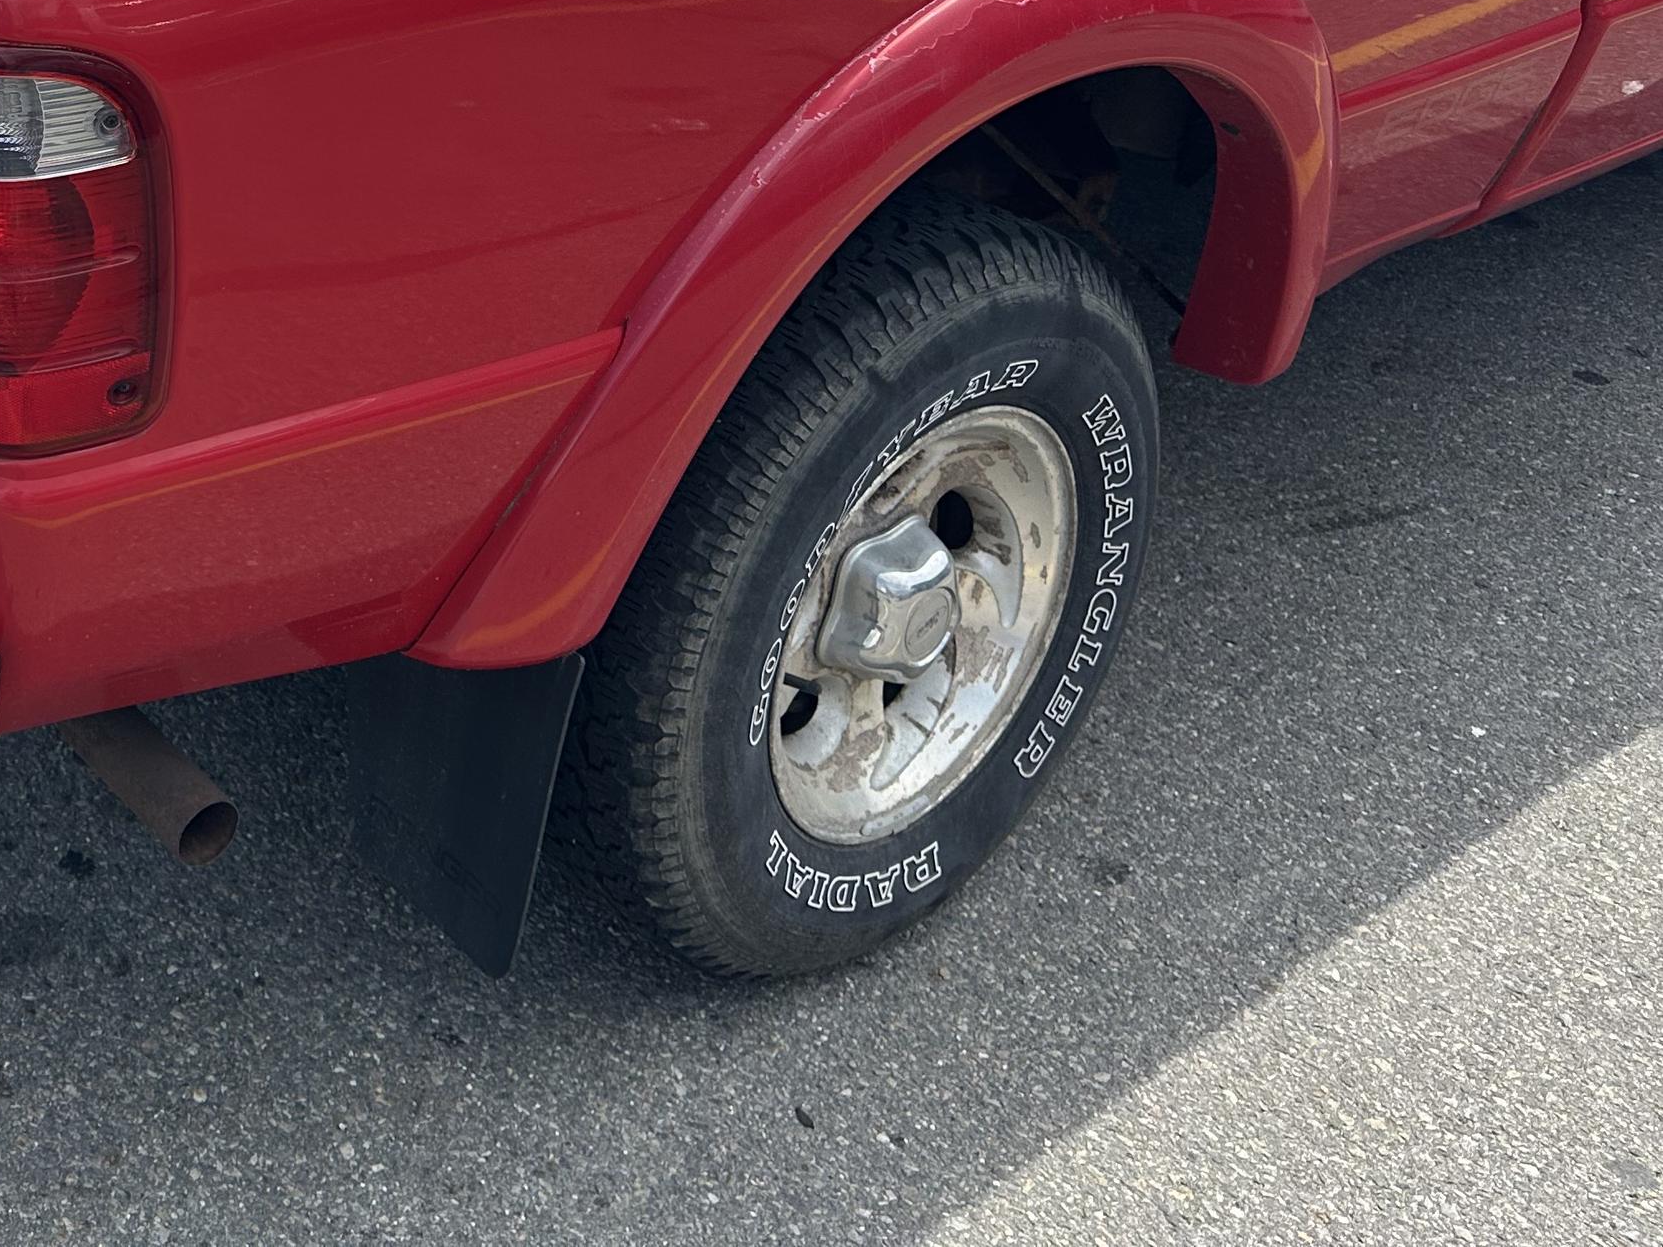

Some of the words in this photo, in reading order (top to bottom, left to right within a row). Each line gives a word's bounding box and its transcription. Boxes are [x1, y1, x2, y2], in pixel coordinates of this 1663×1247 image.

[749, 359, 1039, 746] GOODYEAR
[1013, 393, 1134, 779] WRANGLER
[765, 829, 942, 912] RADIAL
